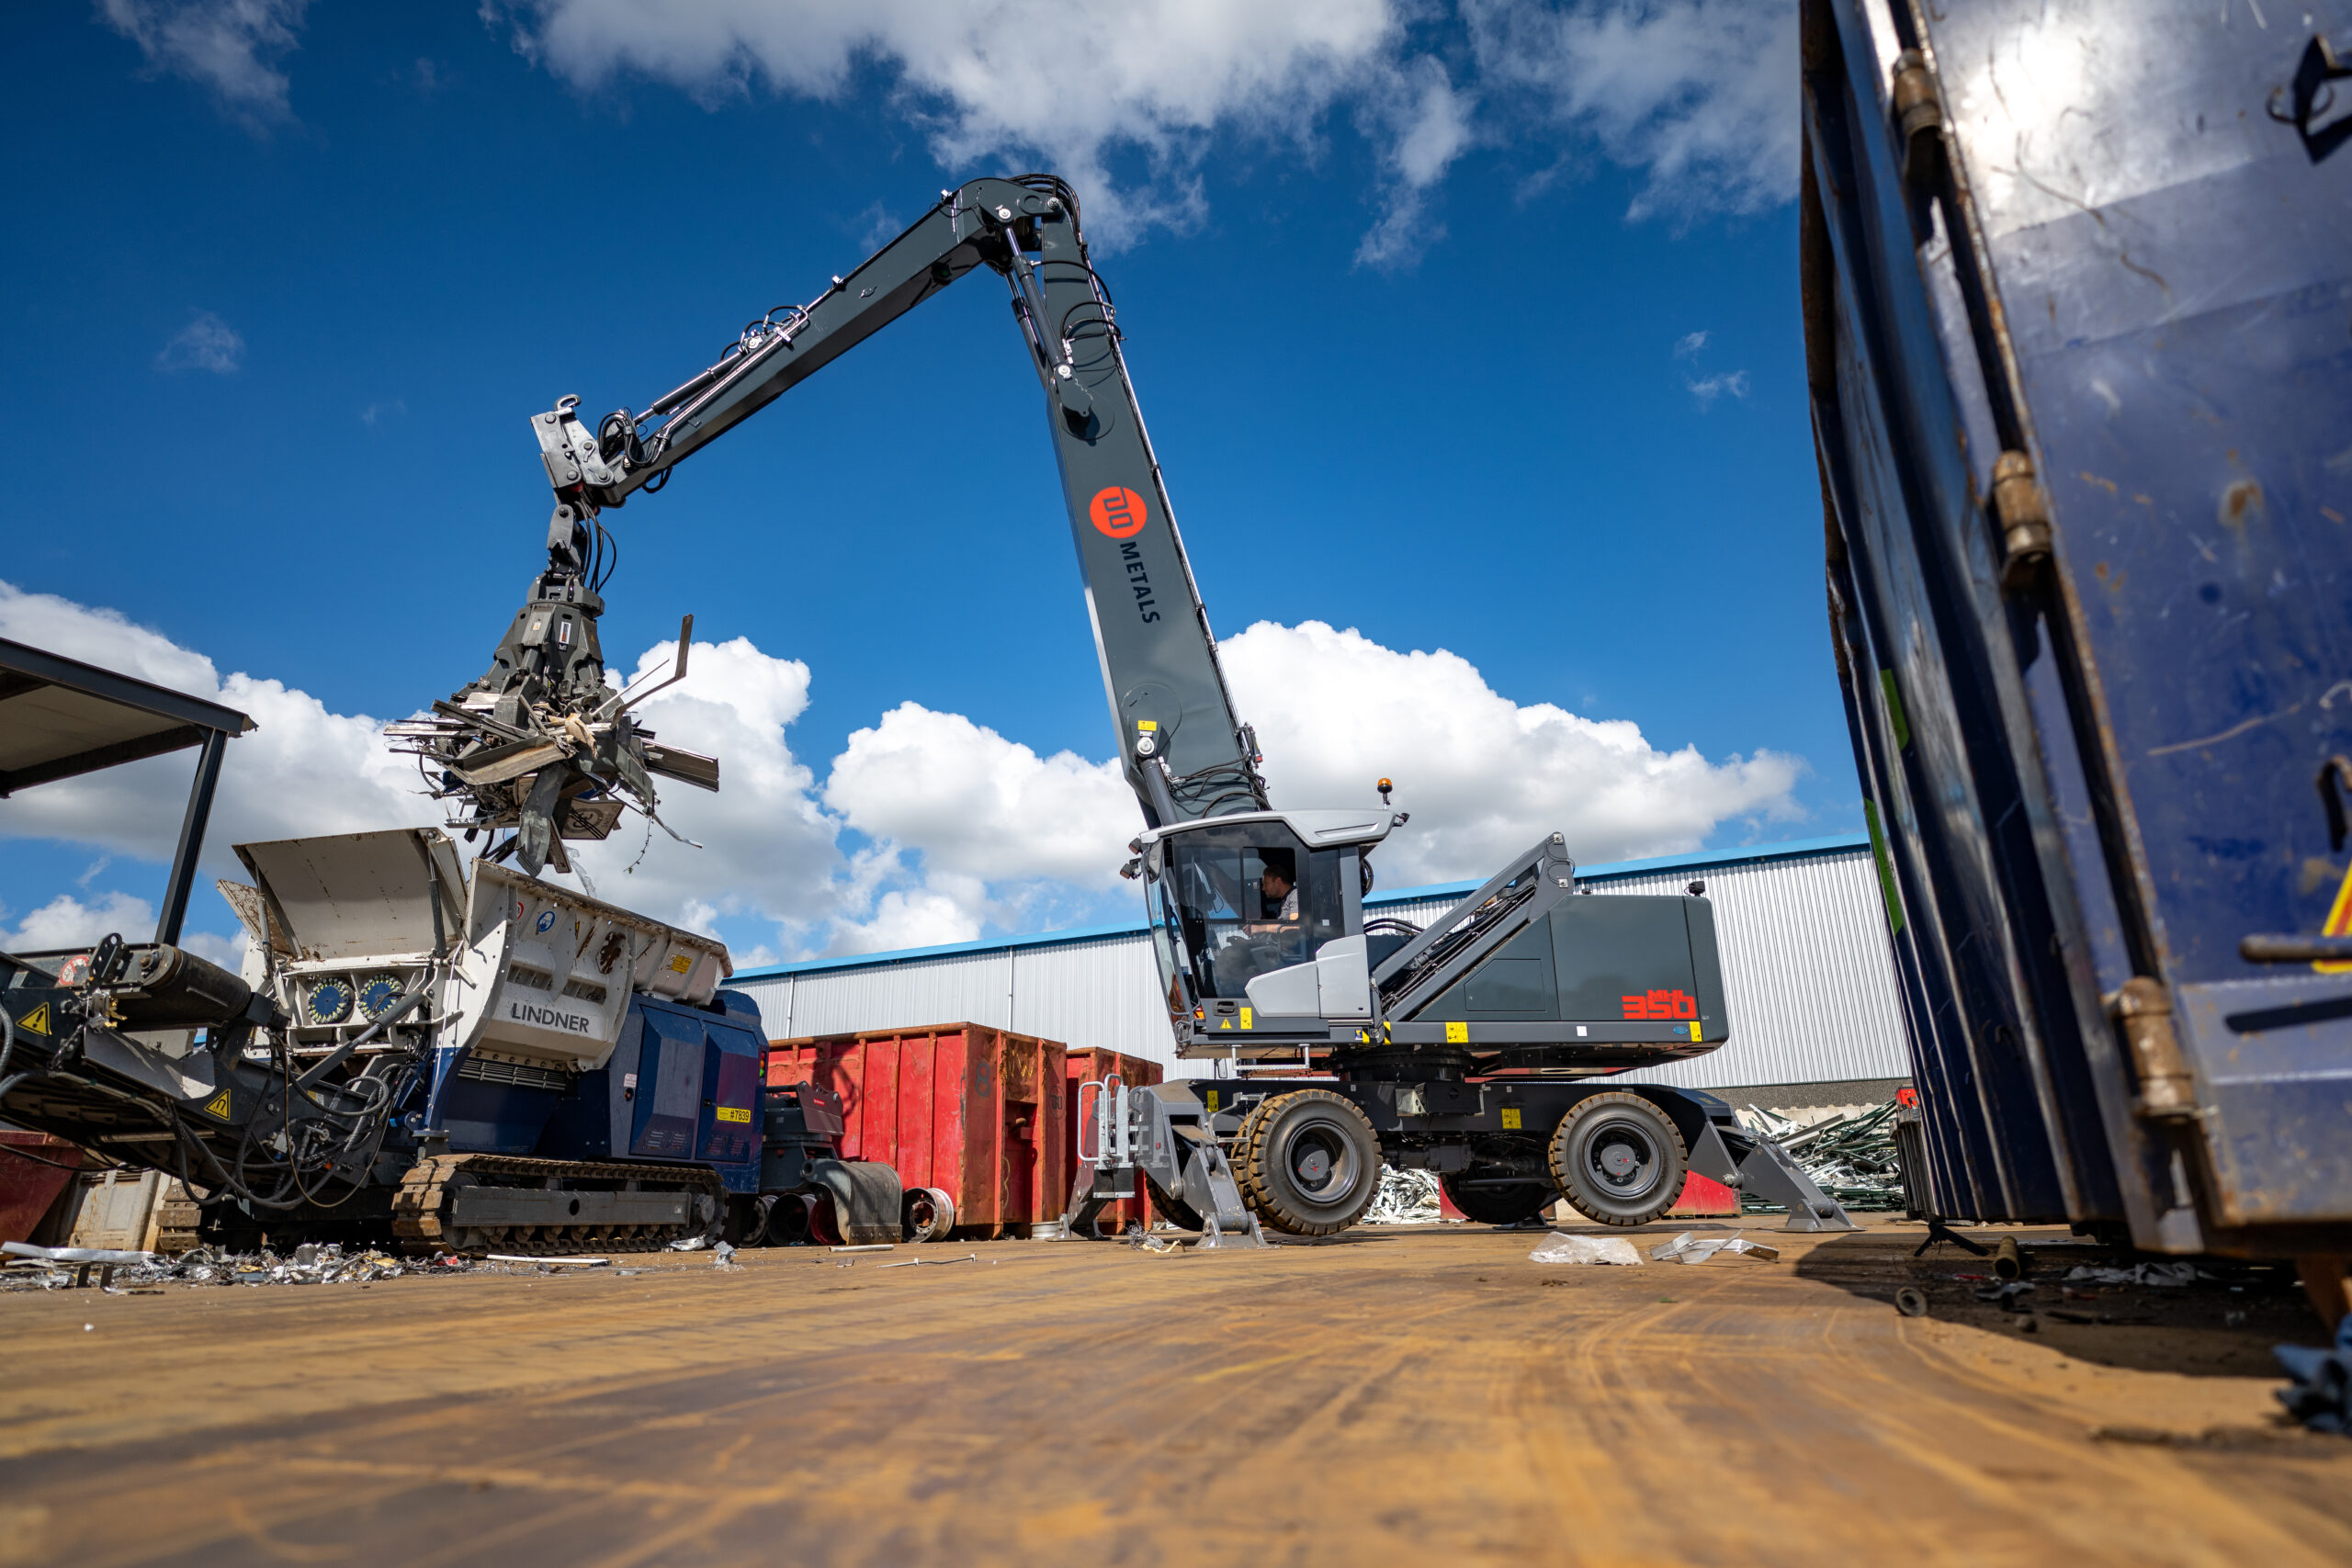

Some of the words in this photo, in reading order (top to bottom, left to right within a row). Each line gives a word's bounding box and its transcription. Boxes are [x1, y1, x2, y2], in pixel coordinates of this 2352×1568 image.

[1119, 541, 1160, 624] METALS
[511, 1002, 589, 1032] LINDNER
[1621, 995, 1697, 1020] 350
[976, 1063, 991, 1097] 8
[729, 1109, 750, 1122] #7839
